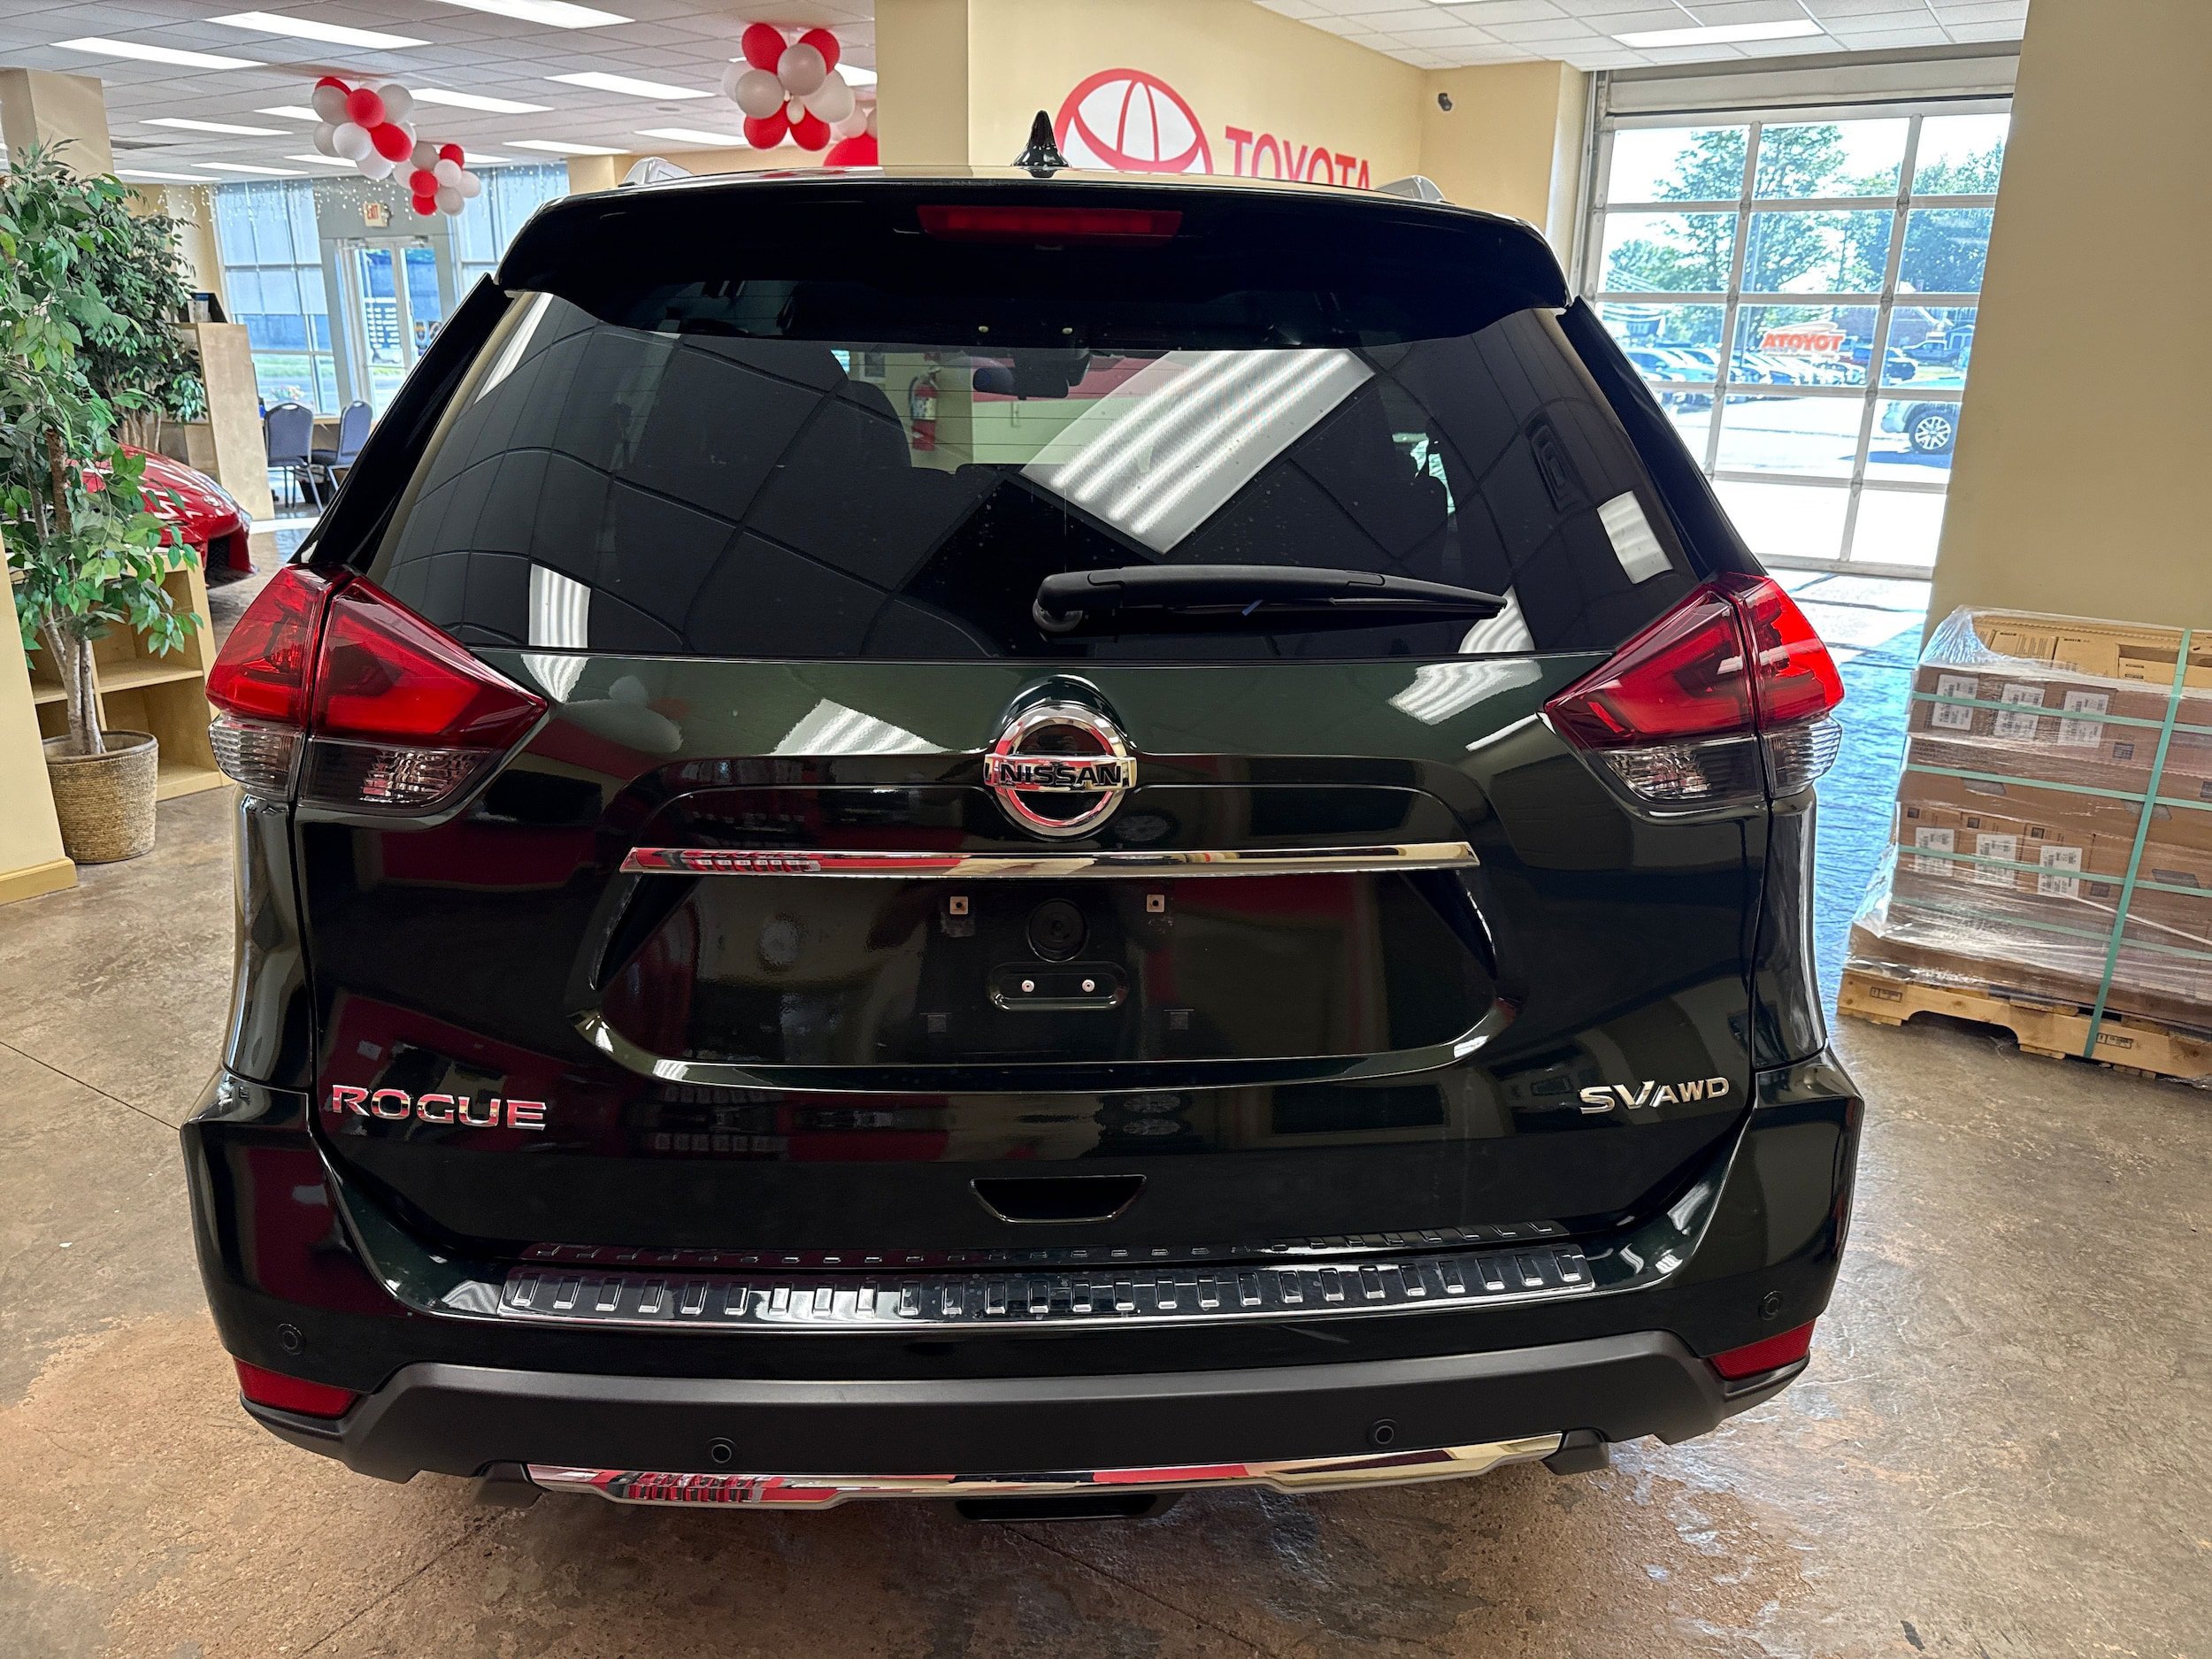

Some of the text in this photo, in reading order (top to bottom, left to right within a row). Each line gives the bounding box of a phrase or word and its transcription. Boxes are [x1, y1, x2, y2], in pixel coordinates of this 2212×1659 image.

[1000, 763, 1122, 787] NISSAN
[332, 1085, 547, 1131] ROGUE
[1579, 1076, 1730, 1115] SV AWD
